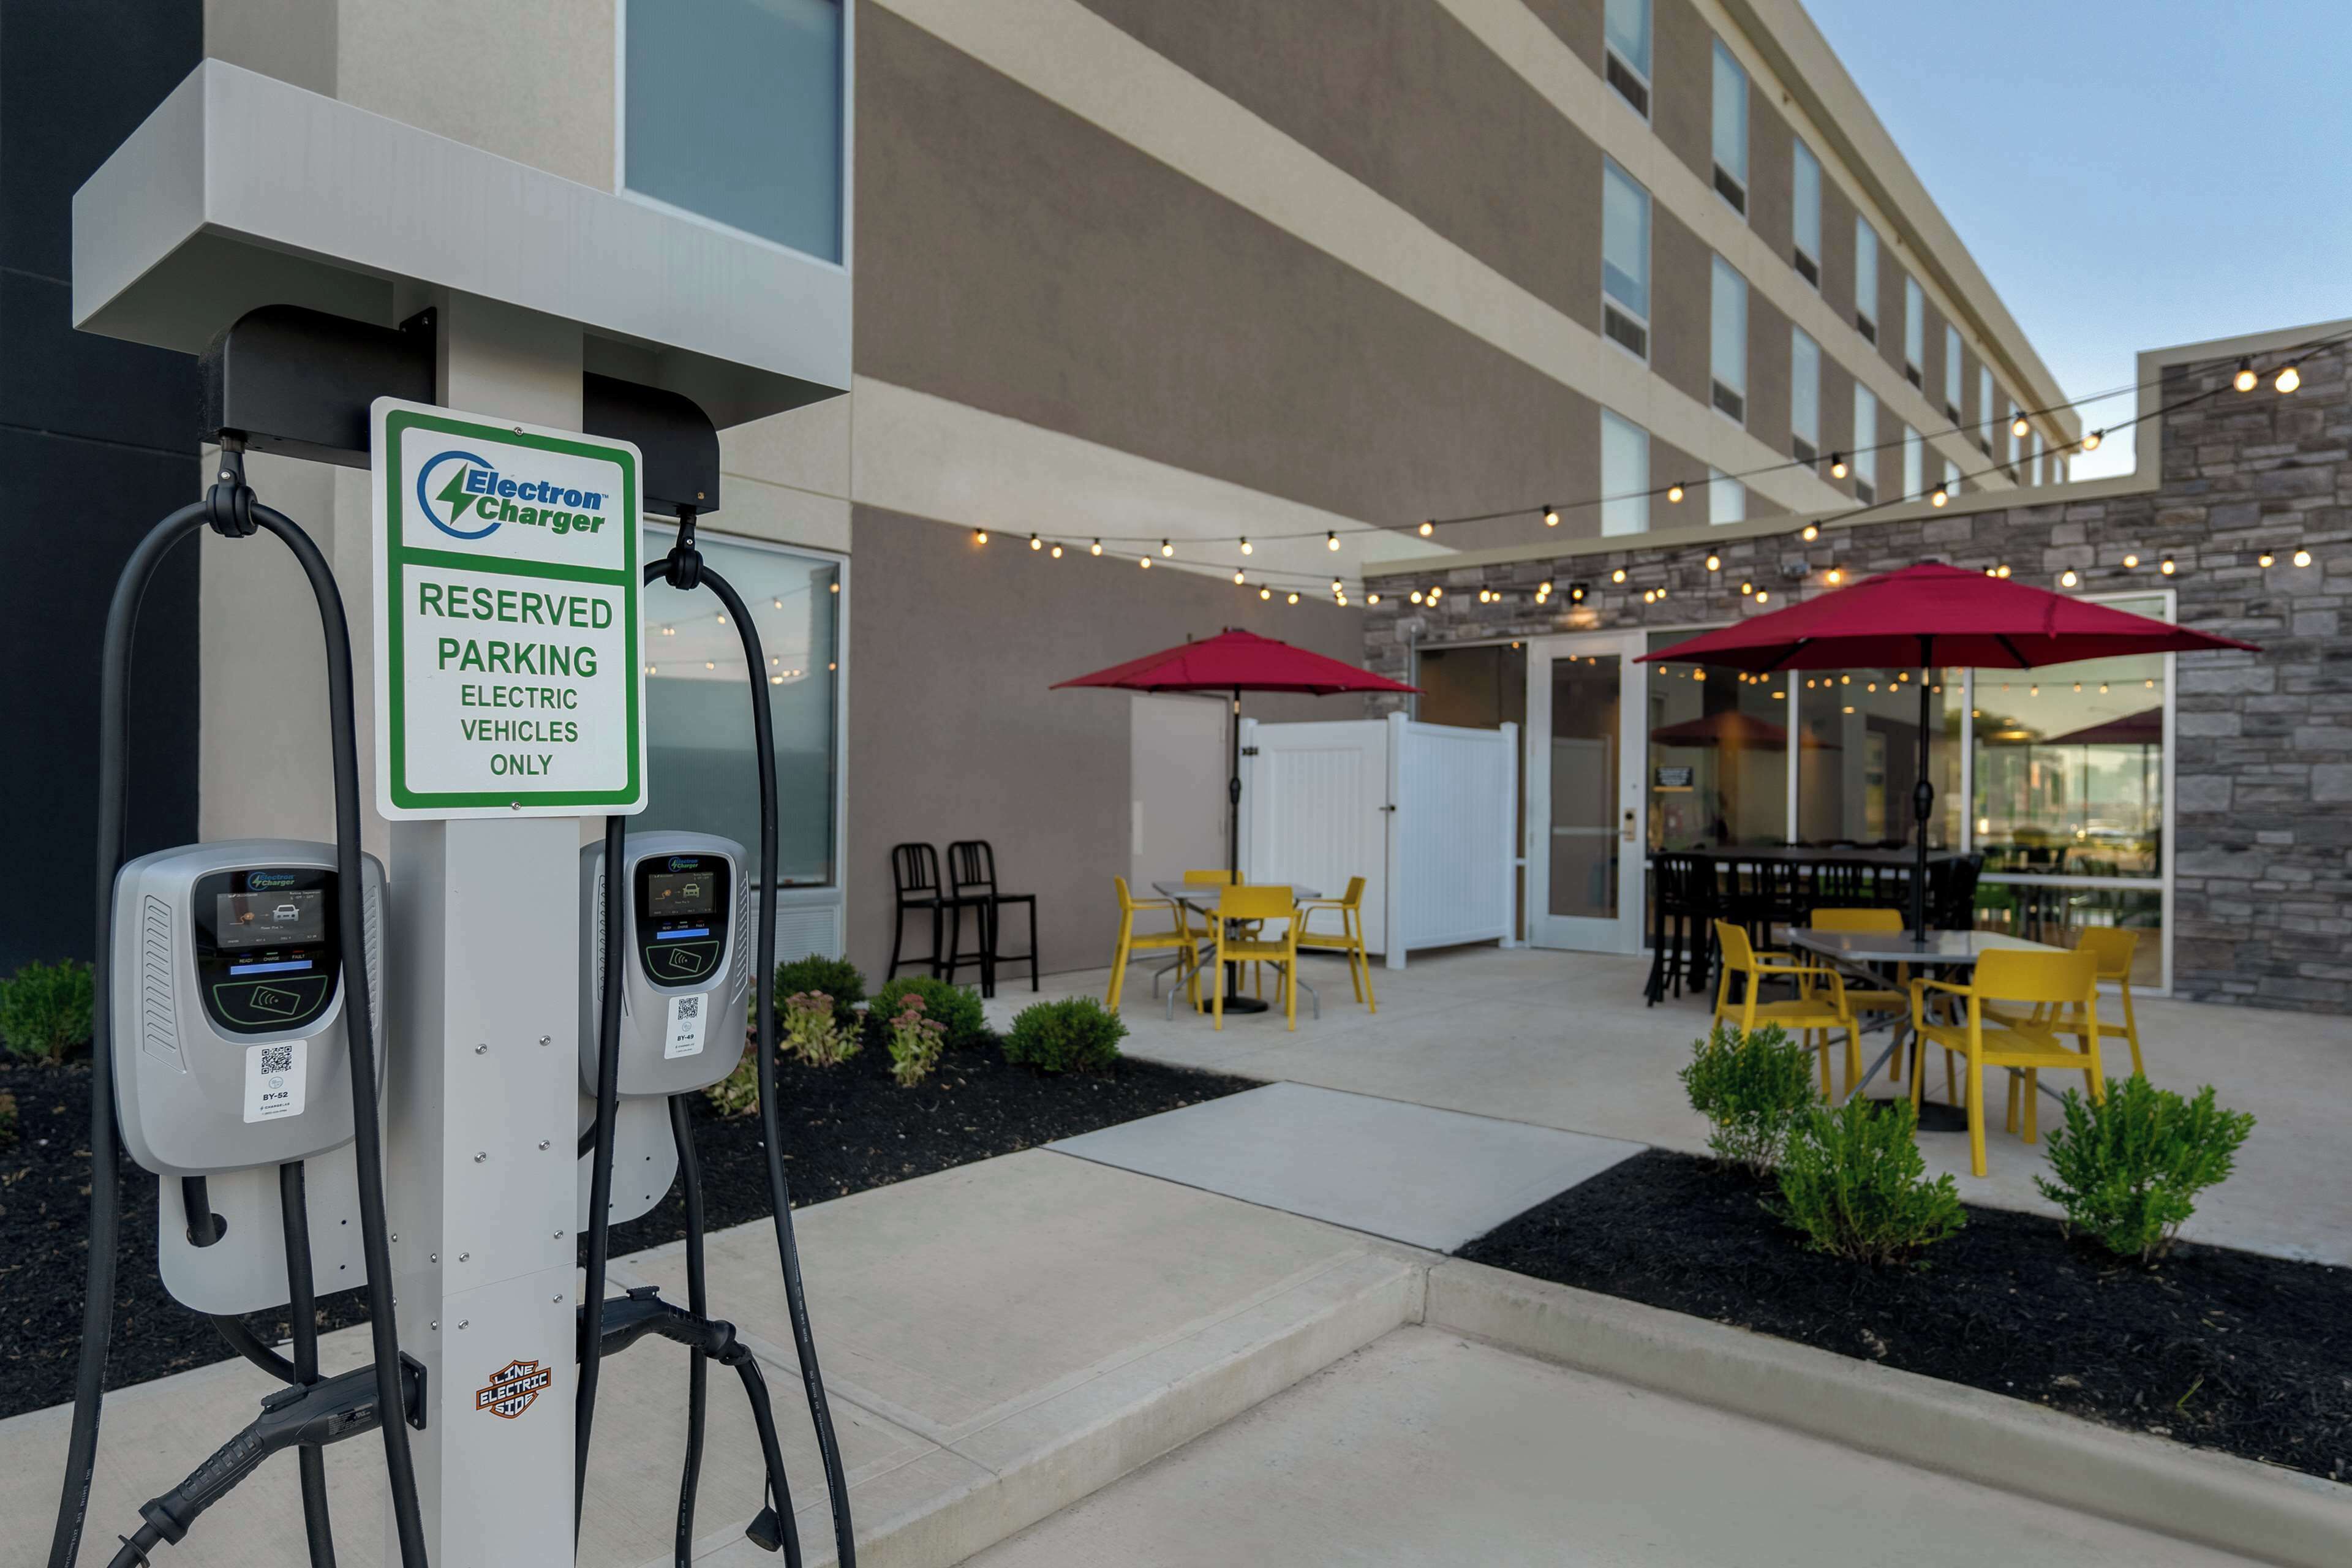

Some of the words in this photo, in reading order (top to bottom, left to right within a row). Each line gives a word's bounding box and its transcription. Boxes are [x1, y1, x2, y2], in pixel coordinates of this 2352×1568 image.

[466, 469, 601, 510] Electron
[476, 494, 606, 535] Charger
[420, 582, 612, 629] RESERVED
[439, 638, 598, 677] PARKING
[461, 685, 578, 709] ELECTRIC
[461, 719, 578, 742] VEHICLES
[491, 754, 553, 775] ONLY
[263, 1091, 288, 1101] BY-52
[495, 1365, 533, 1384] LINE
[480, 1373, 547, 1405] ELECTRIC
[495, 1393, 533, 1415] SIDE
